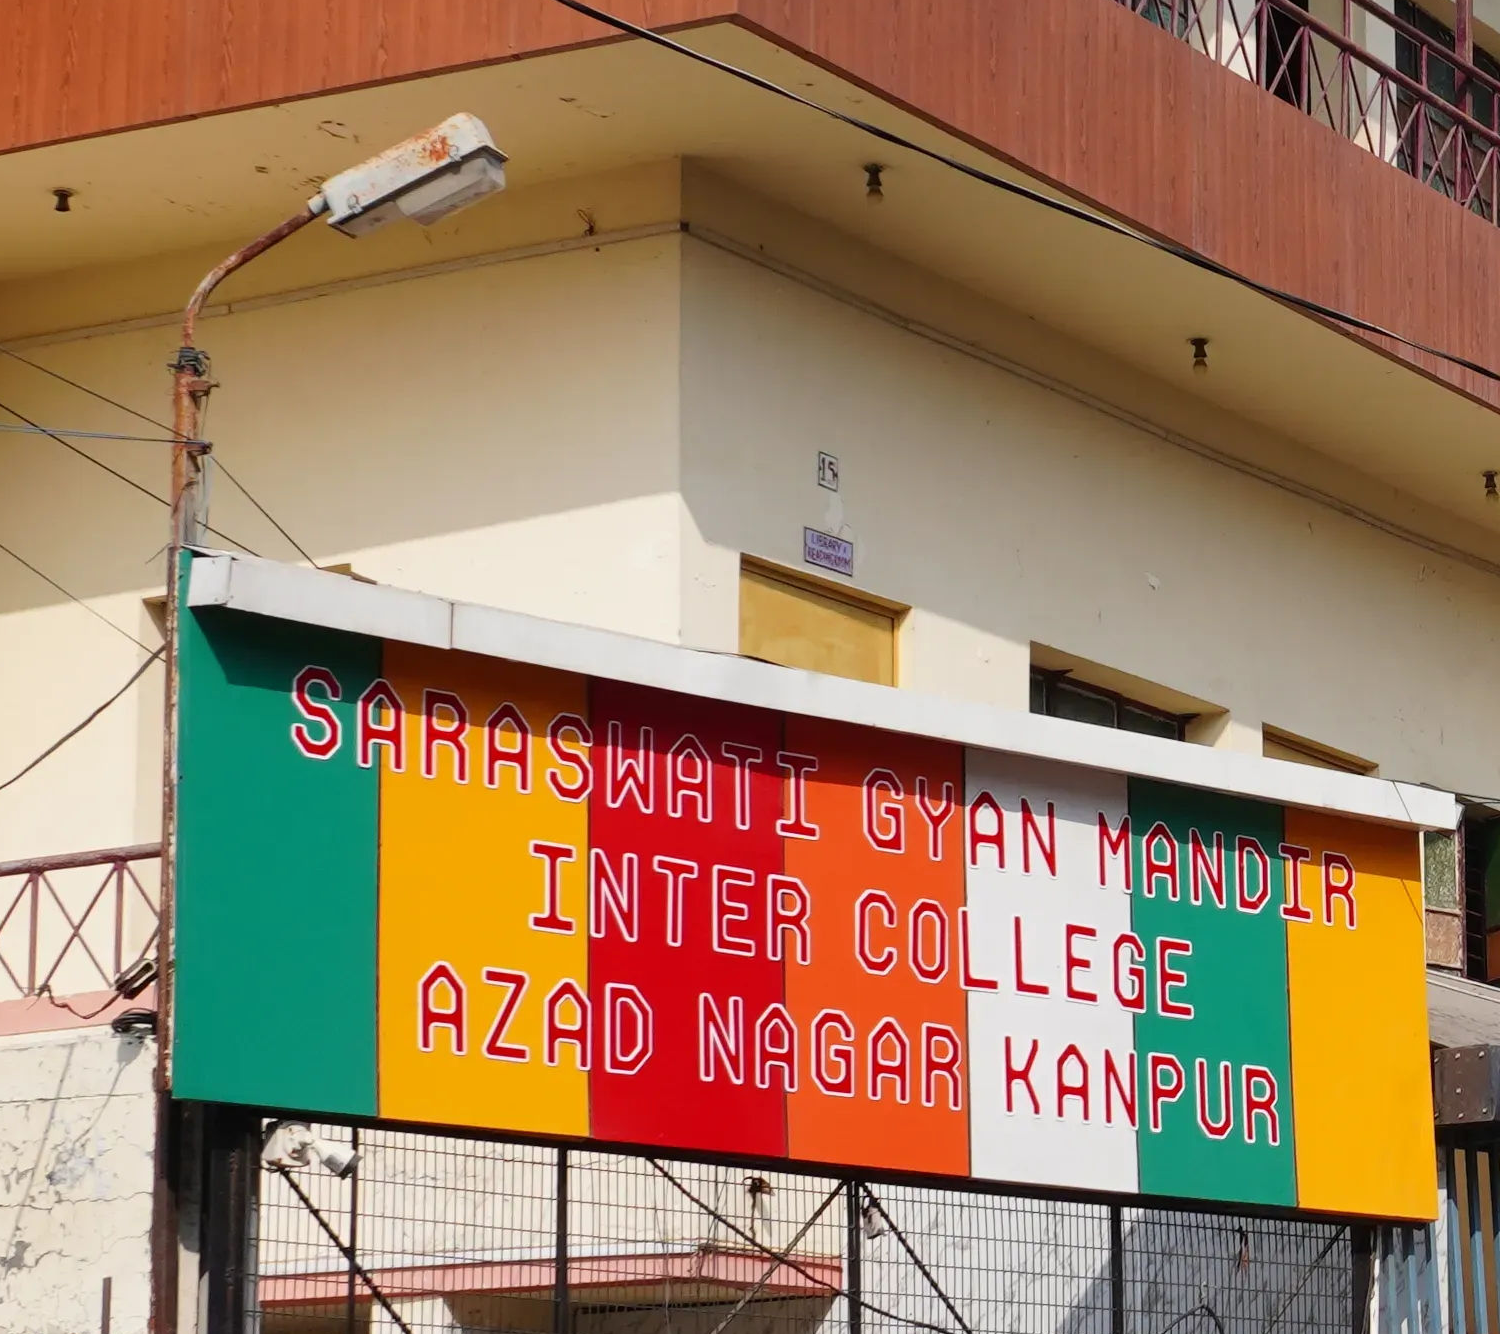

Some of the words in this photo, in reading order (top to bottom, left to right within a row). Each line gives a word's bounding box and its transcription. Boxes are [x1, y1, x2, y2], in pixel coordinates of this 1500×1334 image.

[290, 664, 820, 841] SARASWATI
[861, 768, 1058, 878] GYAN
[1095, 814, 1357, 930] MANDIR
[530, 840, 812, 966] INTER
[854, 888, 1195, 1019] COLLEGE
[416, 960, 653, 1076] AZAD
[698, 994, 964, 1111] NAGAR
[1003, 1035, 1282, 1149] KANPUR
